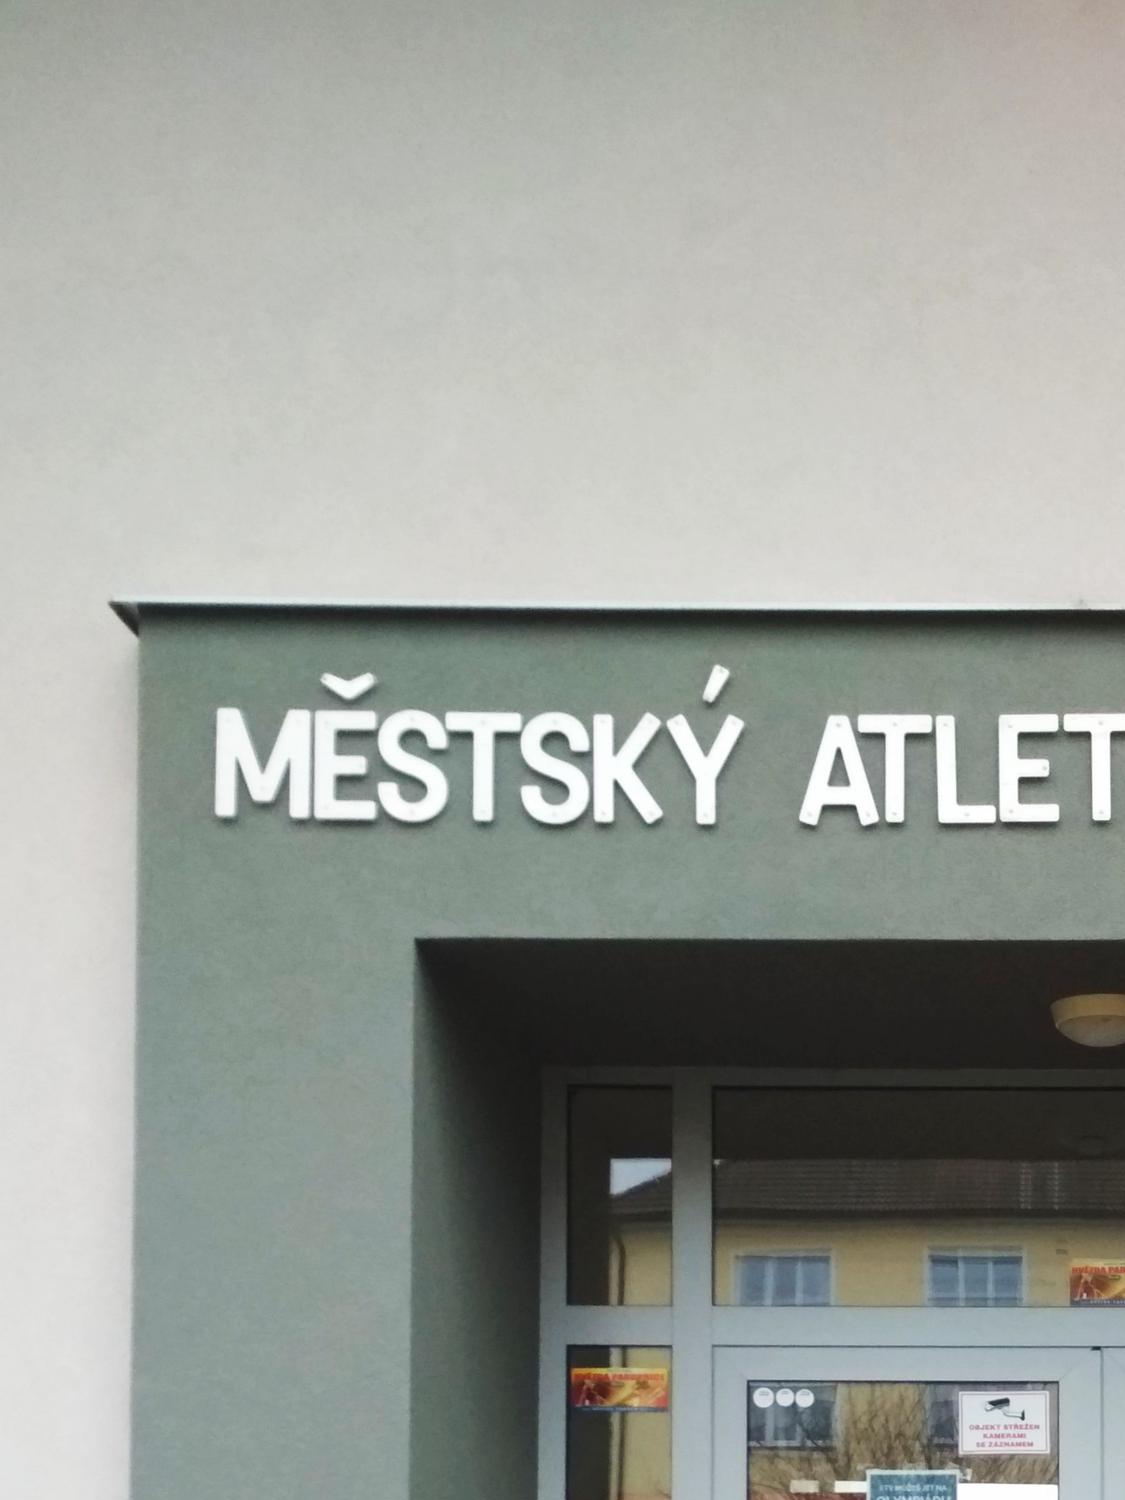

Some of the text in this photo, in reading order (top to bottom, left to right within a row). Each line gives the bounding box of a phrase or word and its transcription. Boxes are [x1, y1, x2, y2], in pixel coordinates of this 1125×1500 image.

[214, 663, 745, 825] MĚSTSKÝ
[1003, 1422, 1040, 1431] STŘEŽEN
[988, 1440, 1034, 1448] ZÁZNAMEM
